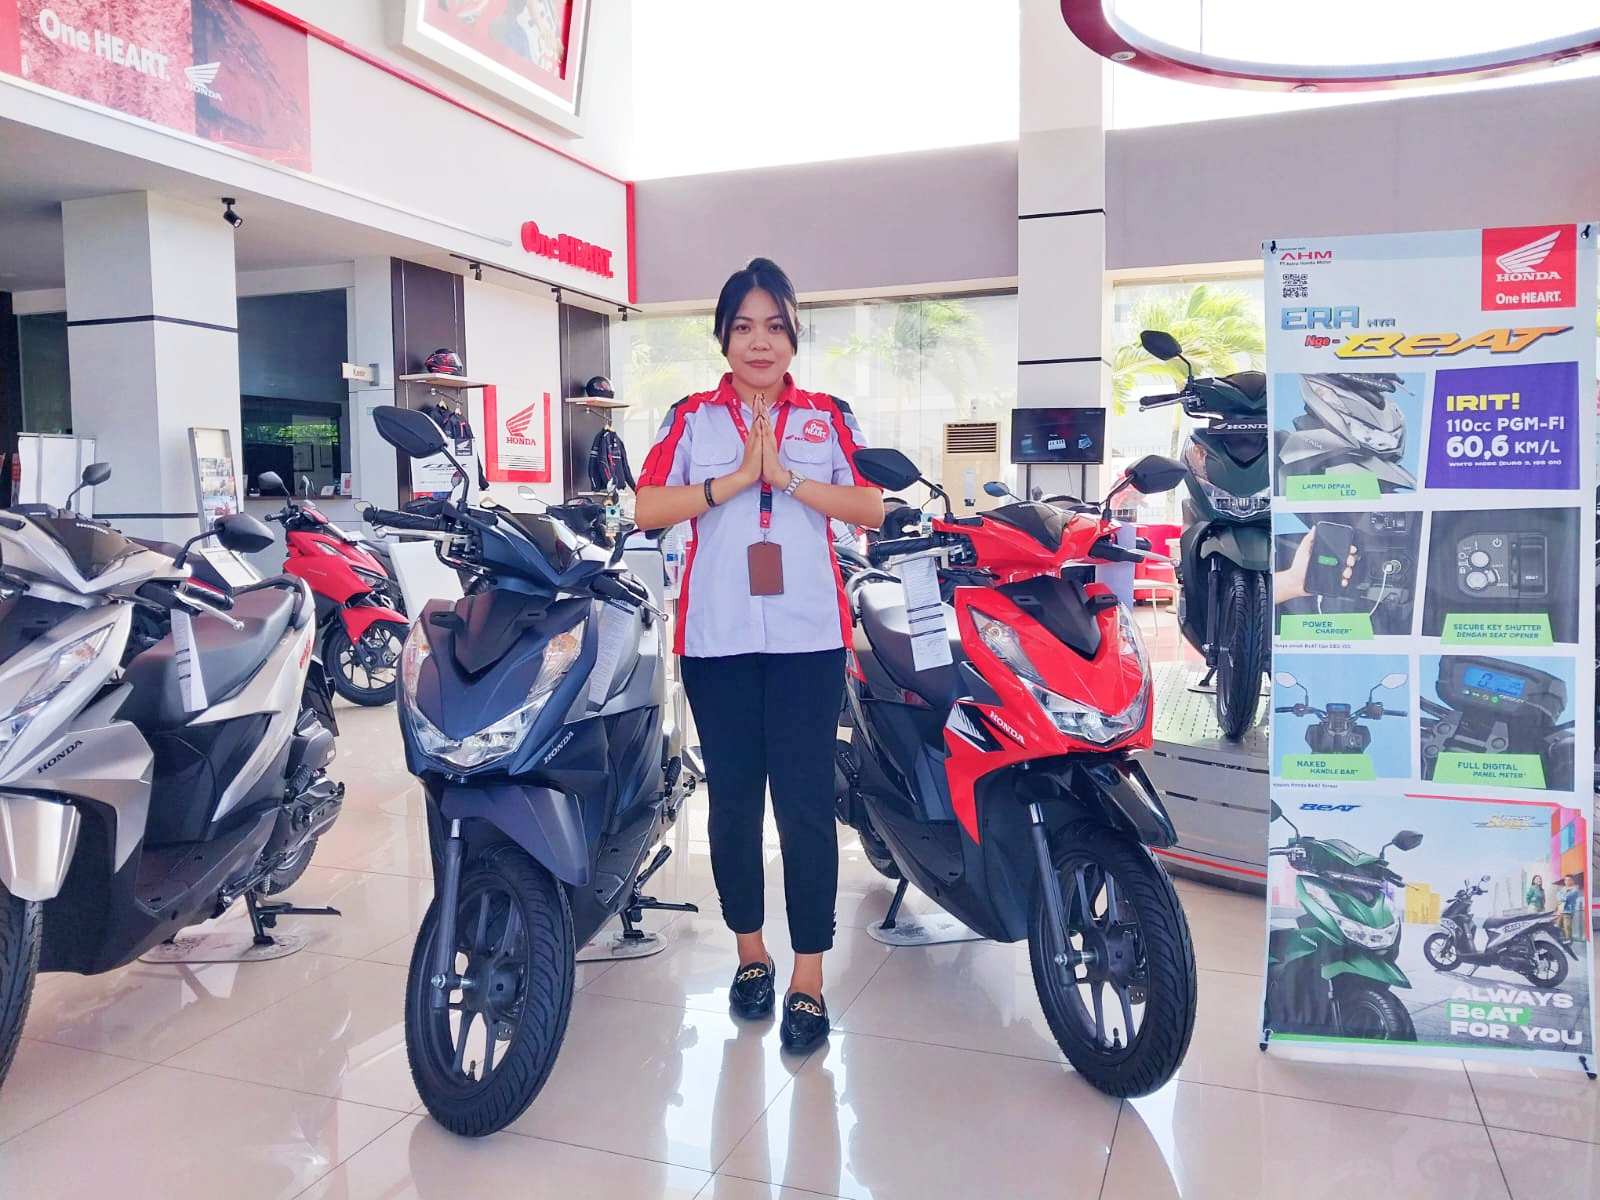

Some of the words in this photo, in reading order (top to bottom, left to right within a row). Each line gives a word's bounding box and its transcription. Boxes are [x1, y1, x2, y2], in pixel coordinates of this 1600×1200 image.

[39, 8, 91, 51] One
[94, 28, 171, 82] HEART.
[185, 83, 223, 101] HONDA
[521, 220, 559, 259] One
[1280, 251, 1333, 261] AHM
[1495, 271, 1562, 283] HONDA
[1495, 293, 1520, 304] One
[1521, 290, 1562, 303] HEART.
[1281, 306, 1360, 331] ERA
[1446, 392, 1520, 412] IRIT!
[1446, 418, 1492, 433] 110cc
[1497, 416, 1565, 432] PGM-FI
[506, 436, 536, 446] HONDA
[1446, 434, 1509, 460] 60,6
[1514, 440, 1560, 456] KM/L
[1340, 489, 1357, 497] LED
[990, 710, 1026, 745] HONDA
[36, 740, 84, 775] HONDA
[543, 730, 575, 765] HONDA
[1457, 762, 1480, 770] FULL
[1482, 762, 1518, 771] DIGITAL
[1299, 803, 1363, 812] BeAT
[1451, 986, 1574, 1009] ALWAYS
[1450, 1003, 1524, 1023] BeAT
[1450, 1020, 1510, 1040] FOR
[1520, 1025, 1583, 1046] YOU
